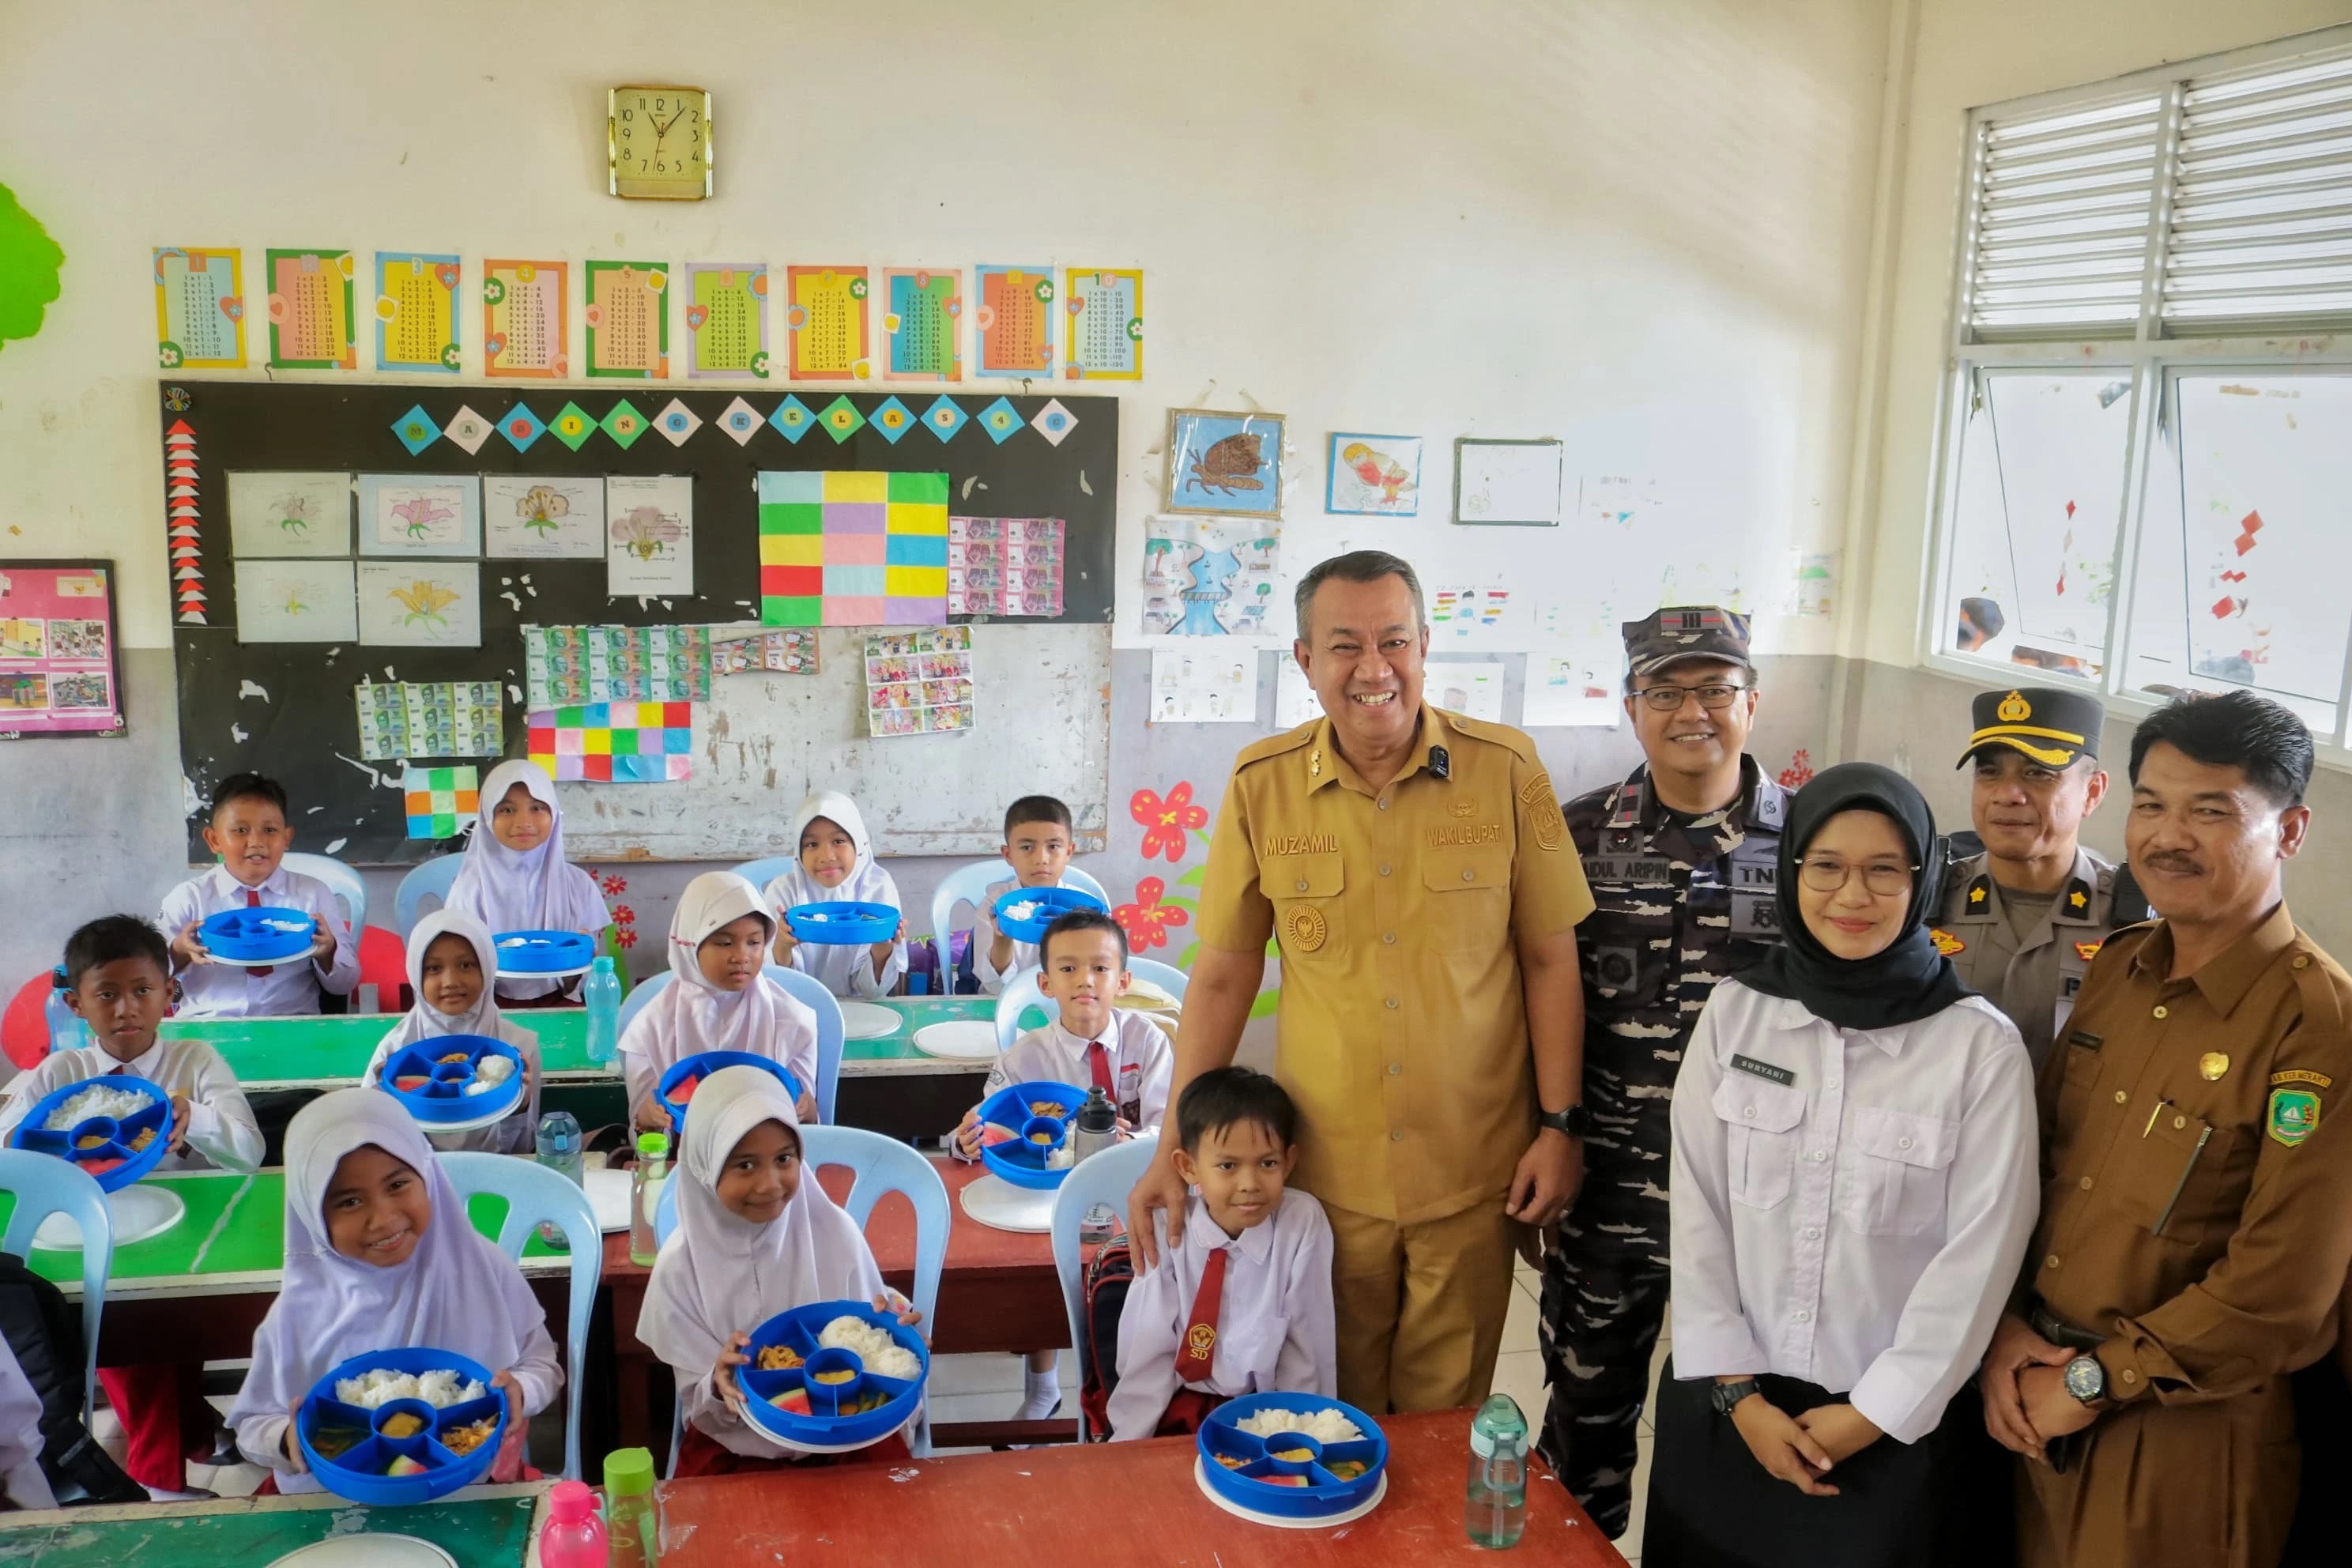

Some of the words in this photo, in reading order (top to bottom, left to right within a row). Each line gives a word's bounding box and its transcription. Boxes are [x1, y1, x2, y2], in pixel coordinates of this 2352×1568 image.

[639, 98, 646, 109] 11
[656, 99, 665, 111] 12
[677, 99, 680, 111] 1
[622, 108, 633, 121] 10
[692, 110, 699, 122] 2
[623, 129, 631, 140] 9
[692, 130, 699, 142] 3
[623, 149, 631, 160] 8
[692, 151, 699, 161] 4
[642, 160, 648, 172] 7
[657, 160, 665, 172] 6
[676, 160, 682, 172] 5
[521, 269, 529, 278] 4
[624, 270, 631, 279] 5
[1093, 272, 1113, 286] 10
[737, 412, 948, 426] KELAS
[1265, 834, 1338, 856] MUZAMIL
[1625, 862, 1668, 880] ARIPIN
[1738, 866, 1777, 884] TN
[1741, 1061, 1784, 1080] SURYANI
[1189, 1348, 1208, 1360] SD
